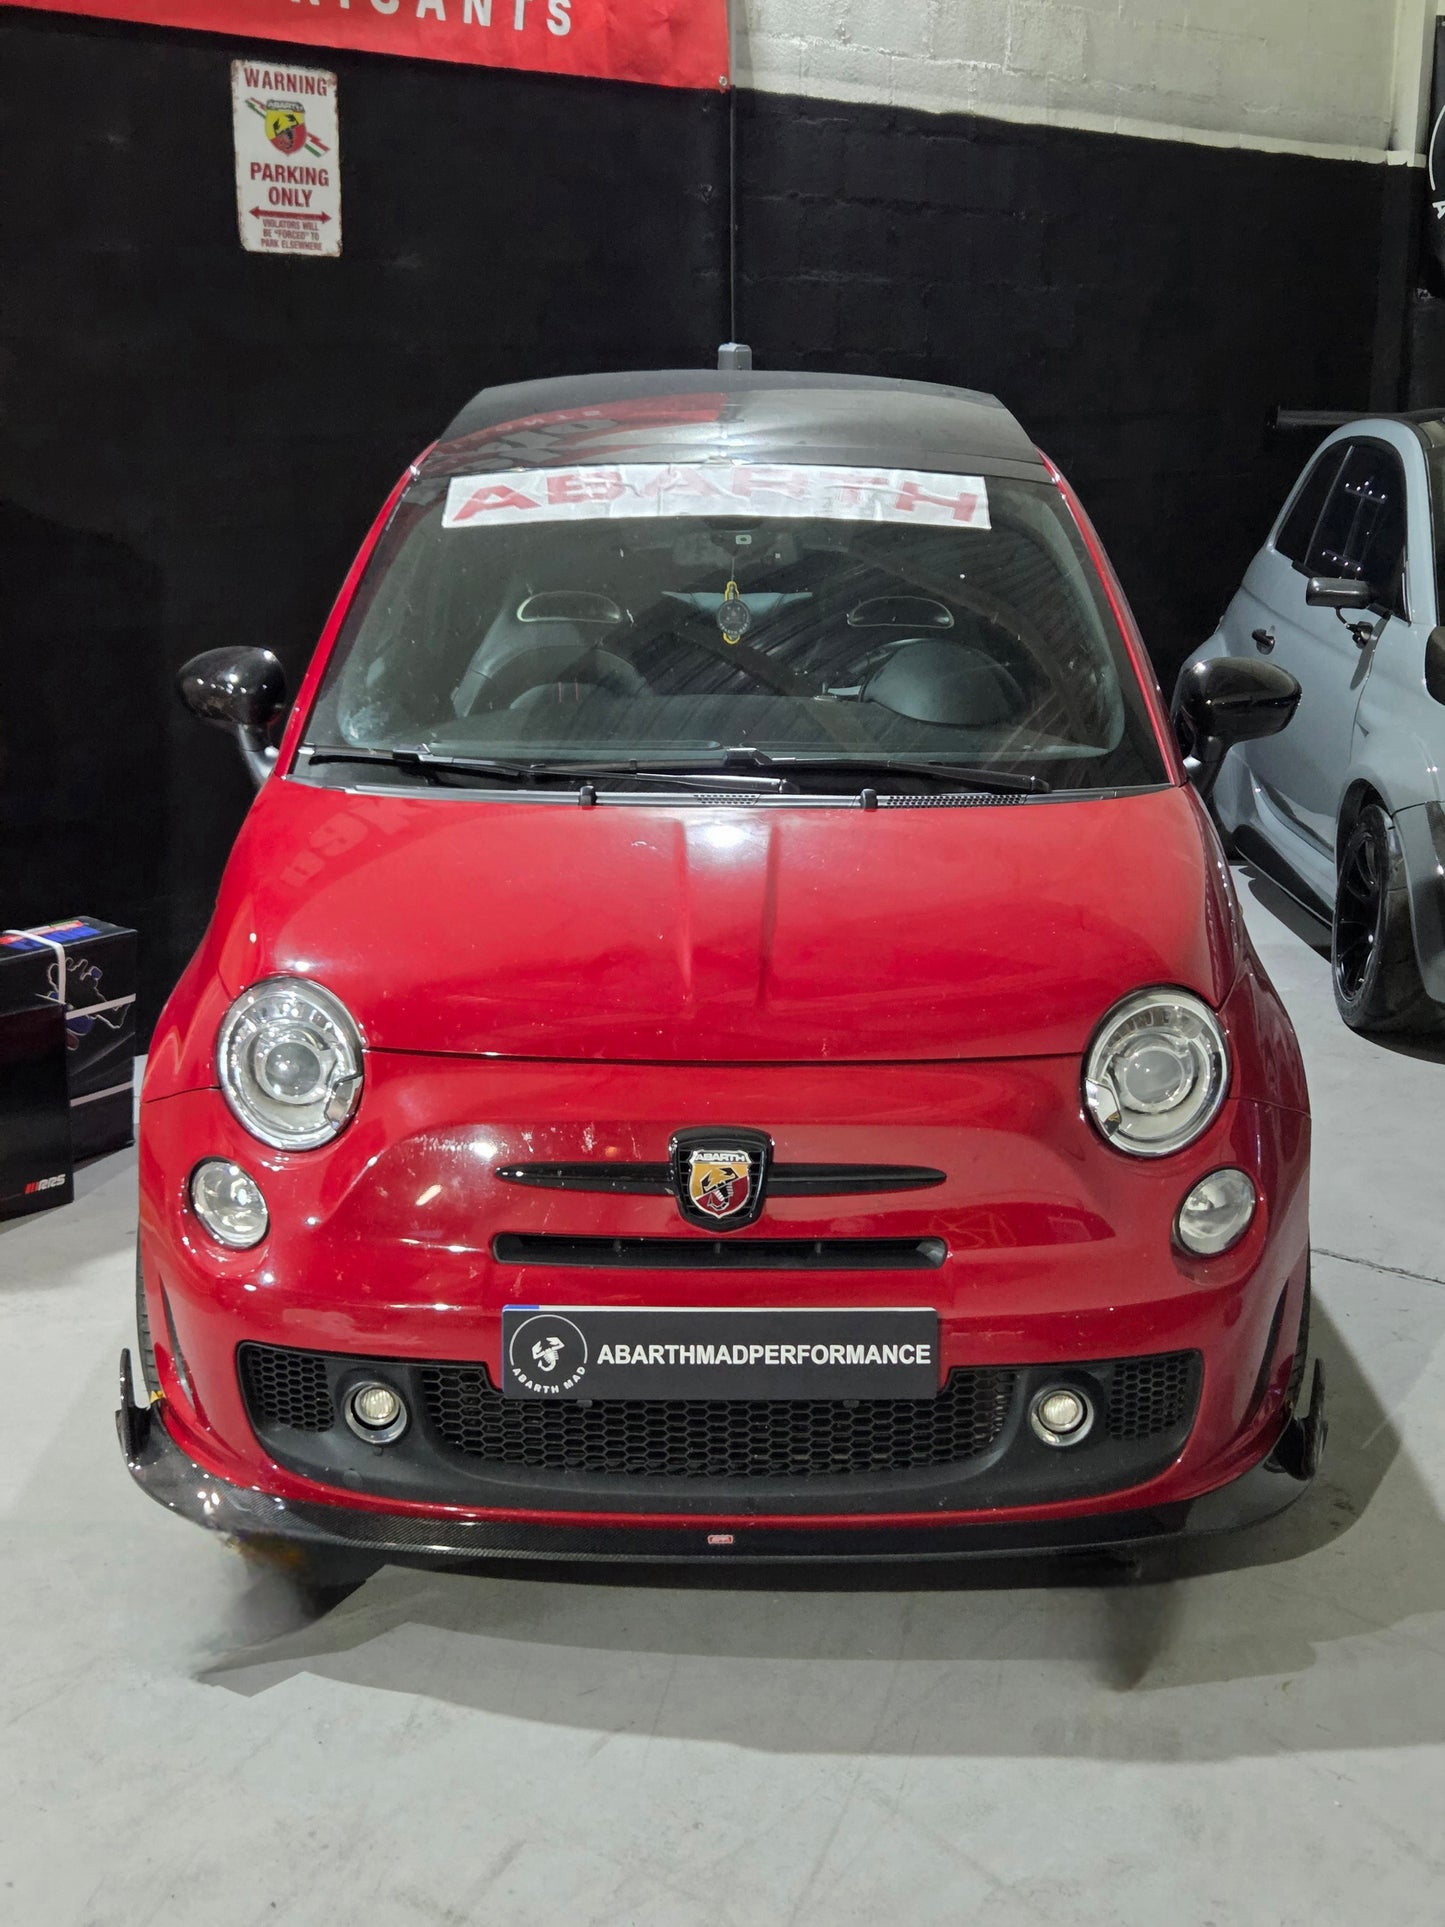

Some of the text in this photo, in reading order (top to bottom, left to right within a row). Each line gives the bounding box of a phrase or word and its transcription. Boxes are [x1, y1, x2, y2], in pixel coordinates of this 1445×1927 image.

[243, 67, 328, 97] WARNING
[250, 162, 329, 187] PARKING
[268, 186, 313, 208] ONLY
[263, 228, 272, 238] BE
[310, 231, 320, 241] TO
[302, 221, 319, 231] WILL
[260, 238, 323, 251] PARK ELSEWHERE
[453, 466, 978, 523] ABARTH
[695, 1152, 745, 1162] ABARTH
[597, 1344, 931, 1366] ABARTHMADPERFORMANCE
[512, 1366, 586, 1394] ABARTH MAD
